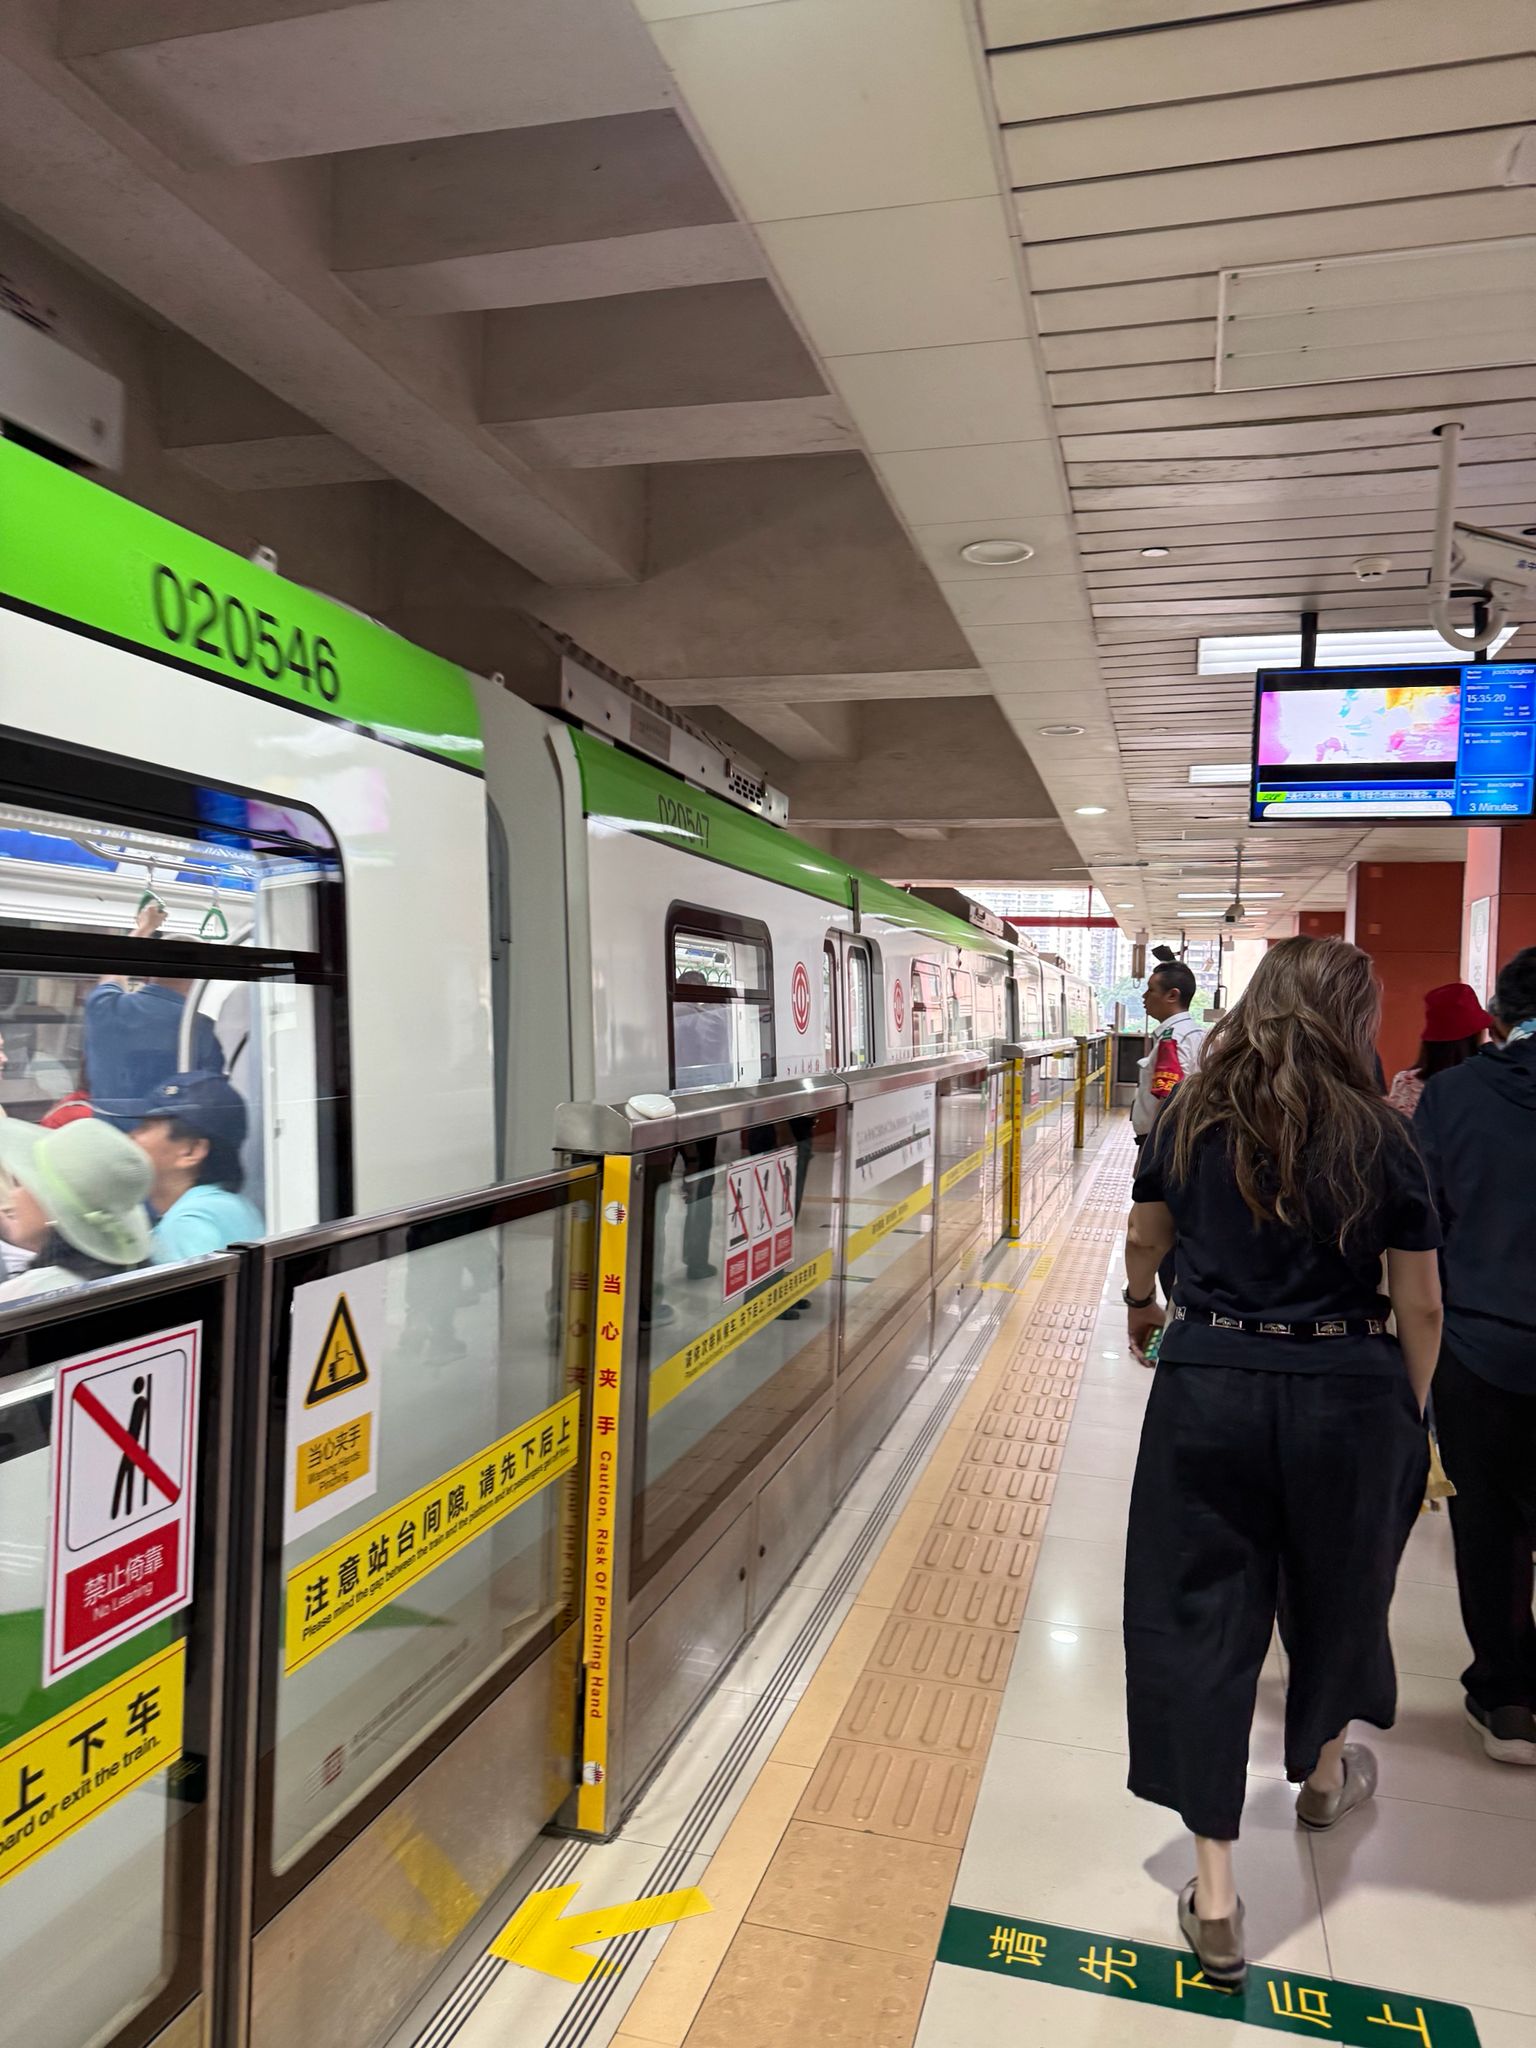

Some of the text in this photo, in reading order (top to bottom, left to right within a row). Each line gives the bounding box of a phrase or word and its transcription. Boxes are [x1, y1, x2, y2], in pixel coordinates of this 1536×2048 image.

[153, 562, 341, 703] 020546
[1467, 693, 1506, 703] 15:35:20
[657, 794, 710, 849] 020547
[1469, 802, 1519, 812] 3 Minutes
[596, 1273, 621, 1436] 当心夹手
[307, 1423, 361, 1469] 当心夹手
[83, 1544, 164, 1608] 禁止倚靠
[92, 1581, 154, 1621] No Leaning
[302, 1610, 331, 1639] Please
[333, 1594, 353, 1617] mind
[355, 1584, 367, 1602] the
[369, 1575, 383, 1594] gap
[385, 1551, 415, 1581] between
[589, 1450, 611, 1719] Caution, Risk Of Pinching Hand
[3, 1685, 160, 1827] 上下车
[39, 1803, 62, 1827] or
[61, 1780, 92, 1812] exit
[93, 1761, 120, 1788] the
[121, 1734, 160, 1768] train.
[988, 1925, 1430, 2048] 请先下后上
